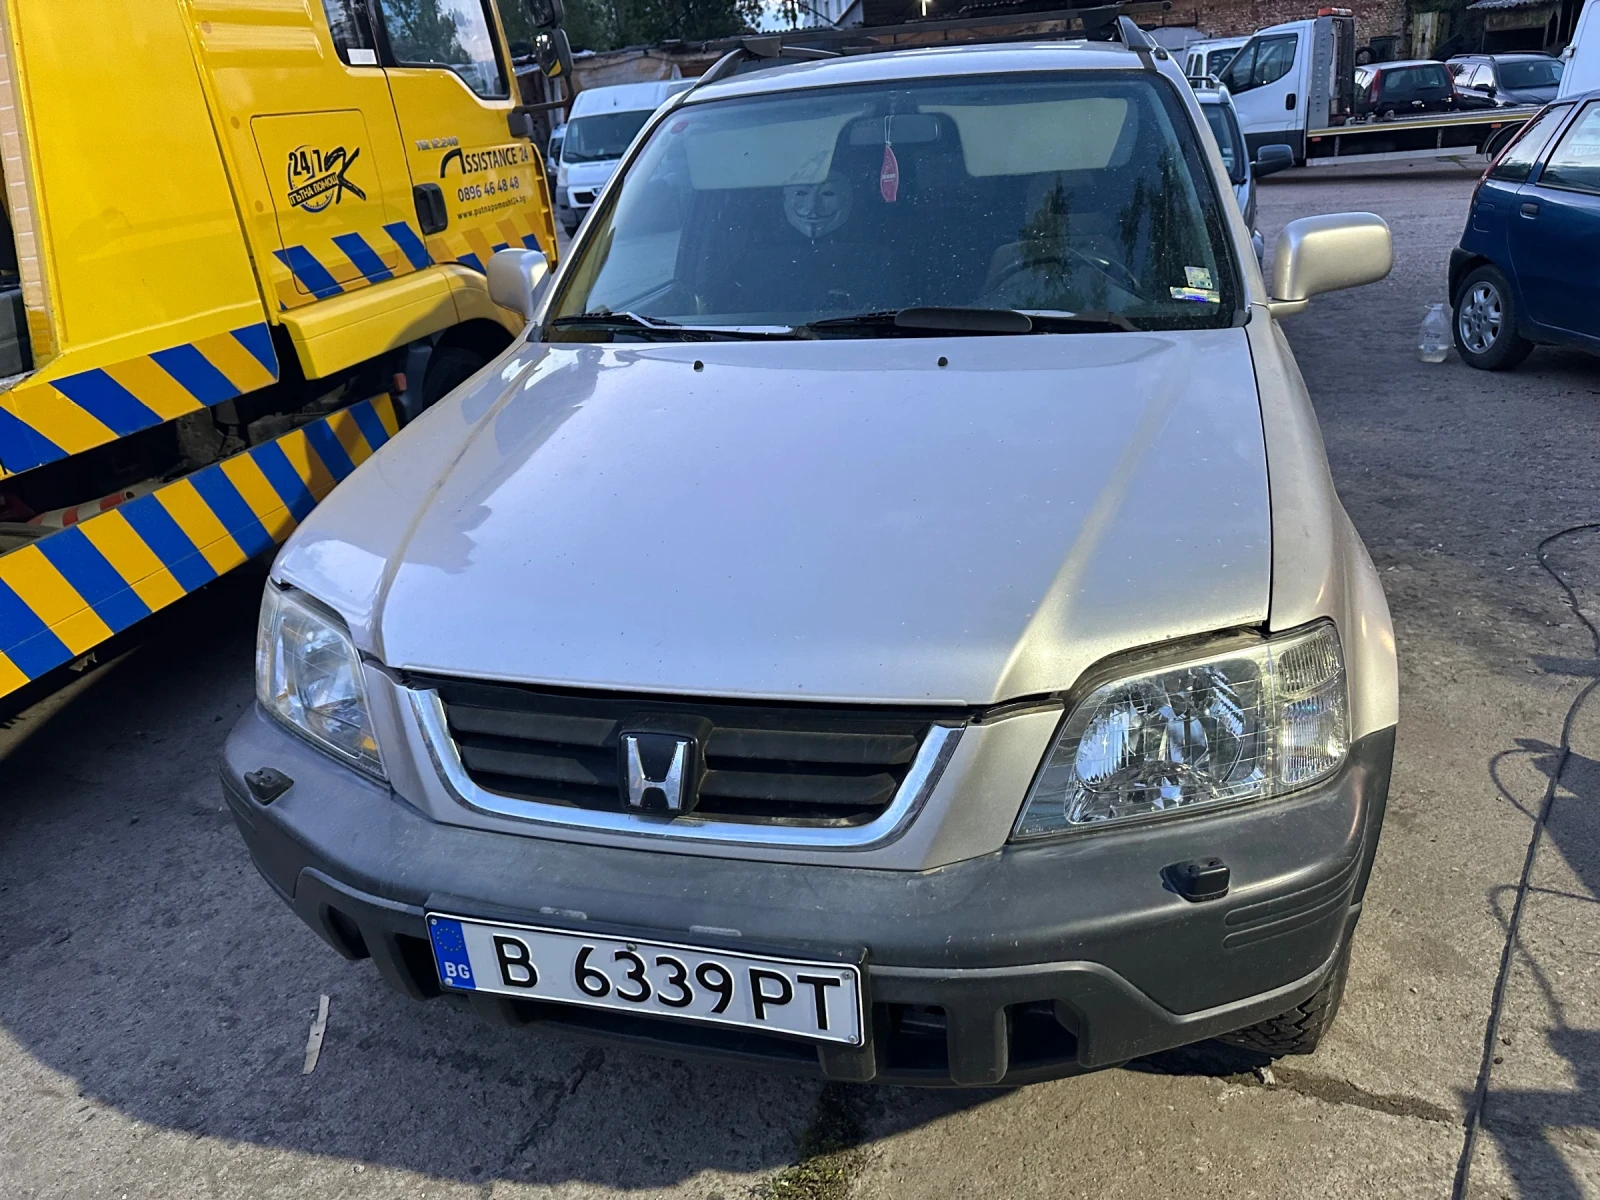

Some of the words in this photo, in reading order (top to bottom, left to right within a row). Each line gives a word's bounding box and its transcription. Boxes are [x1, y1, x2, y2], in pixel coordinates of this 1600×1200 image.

[440, 147, 518, 178] ASSISTANCE
[519, 146, 529, 162] 24
[289, 186, 314, 205] ПЪТНА
[313, 173, 339, 194] ПОМОЩ
[457, 184, 482, 202] 0896
[484, 181, 496, 196] 46
[497, 178, 508, 192] 48
[509, 175, 520, 190] 48
[457, 195, 526, 219] www.putnapomosht24.bg
[444, 961, 470, 979] BG
[493, 935, 539, 989] B
[574, 946, 734, 1014] 6339
[749, 968, 841, 1031] PT
